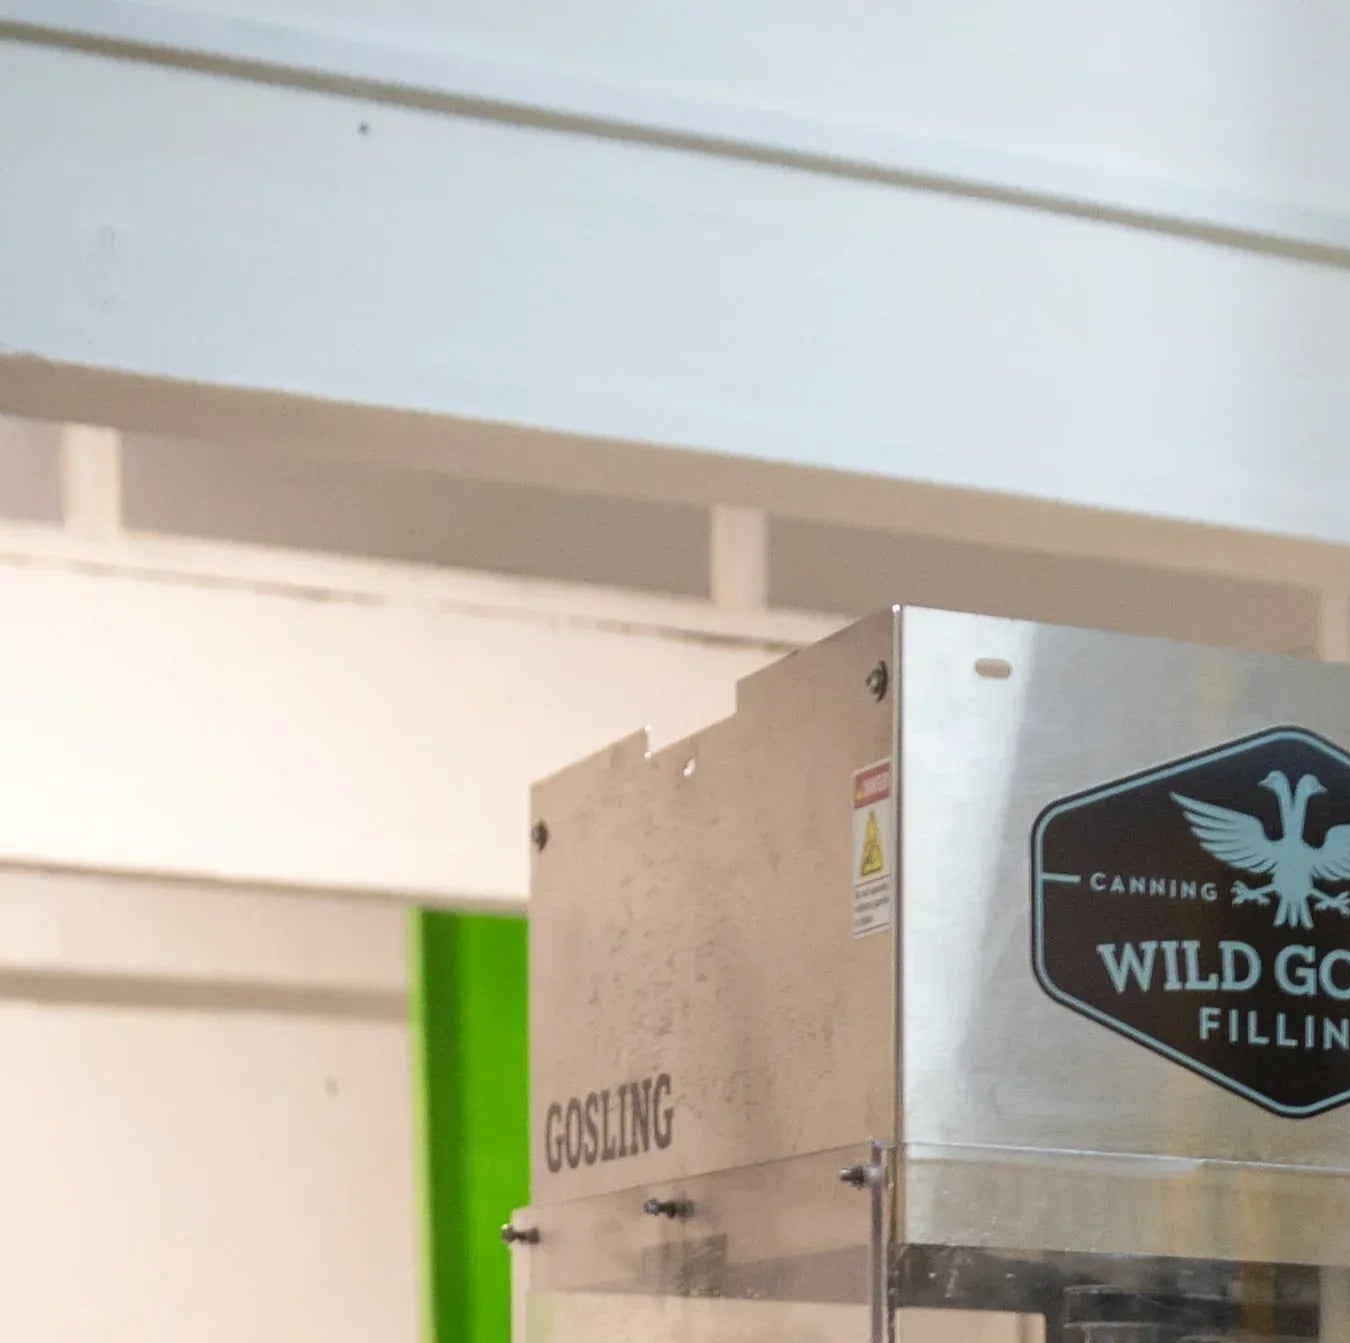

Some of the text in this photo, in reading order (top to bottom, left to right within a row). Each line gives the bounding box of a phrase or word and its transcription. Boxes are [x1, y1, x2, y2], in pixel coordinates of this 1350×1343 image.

[1089, 871, 1218, 902] CANNING
[1096, 939, 1262, 995] WILD
[544, 1072, 675, 1174] GOSLING
